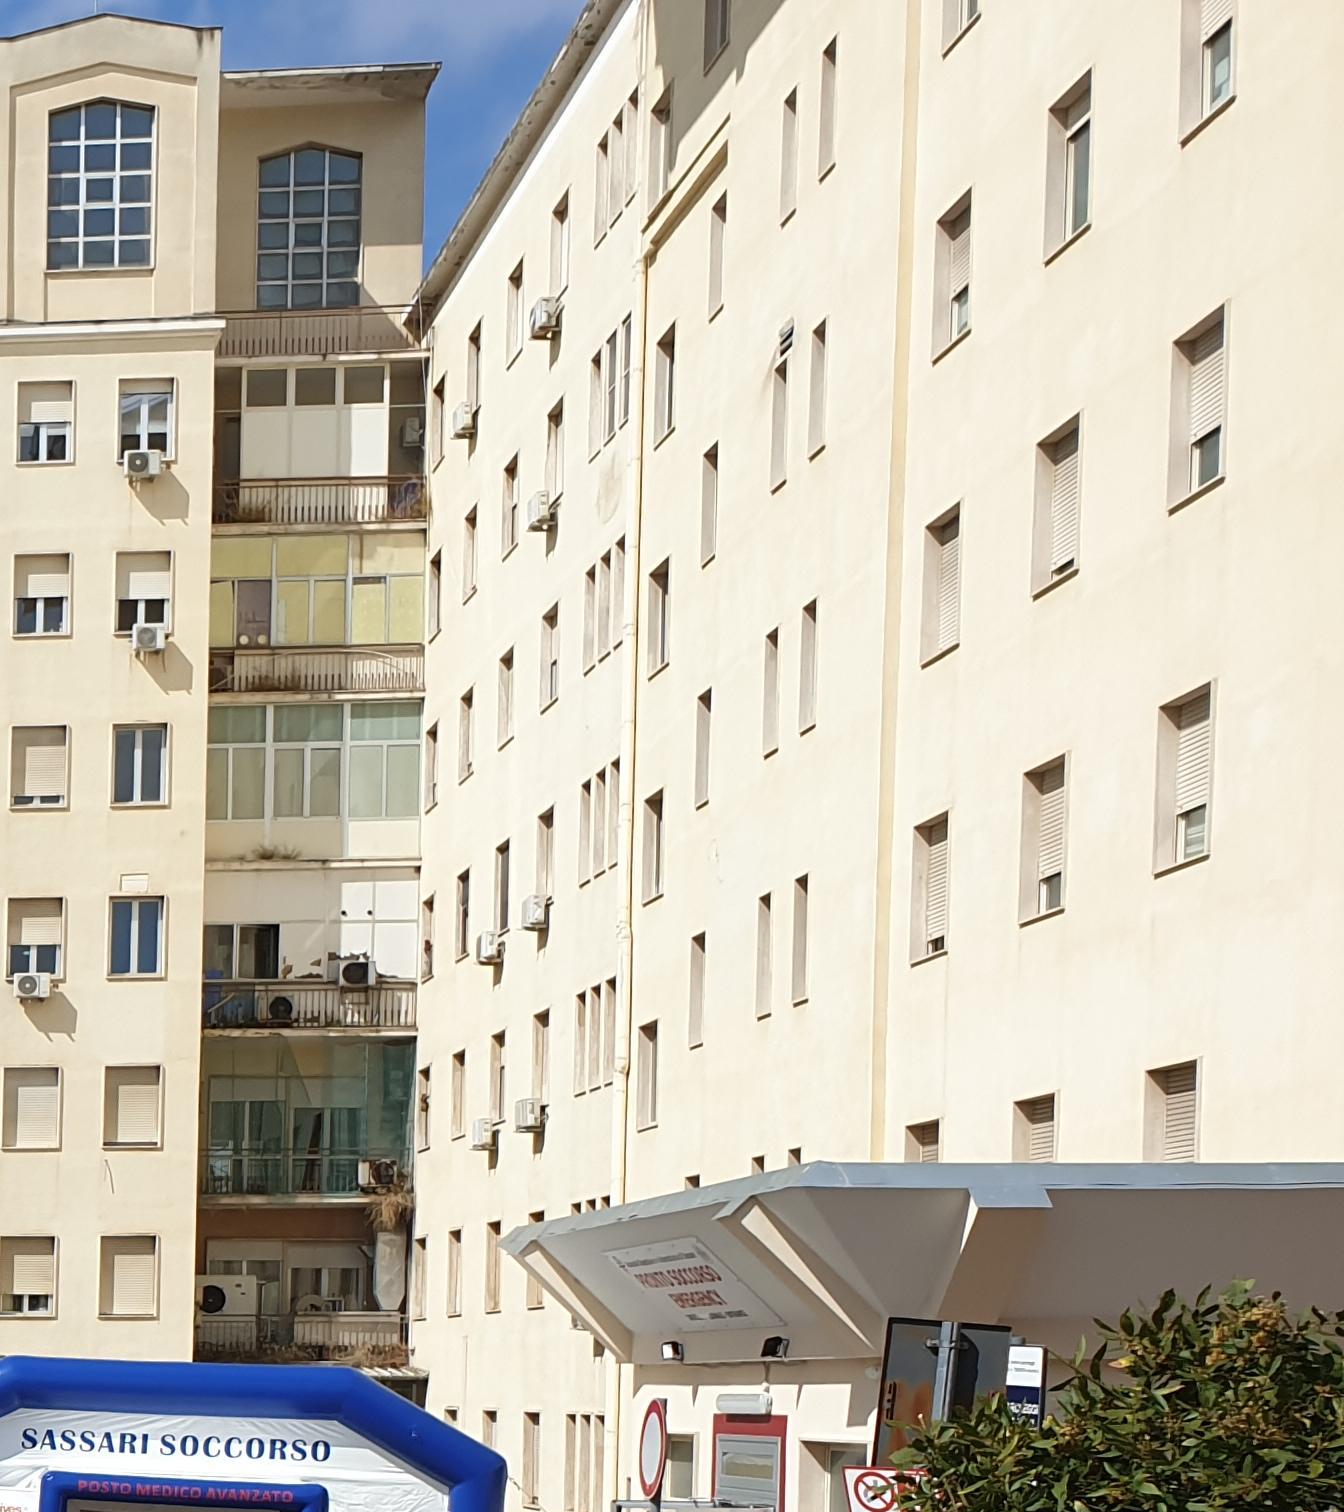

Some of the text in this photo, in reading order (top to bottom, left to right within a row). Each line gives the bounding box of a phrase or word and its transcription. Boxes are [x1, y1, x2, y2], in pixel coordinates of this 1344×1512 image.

[20, 1428, 331, 1462] SASSARI SOCCORSO
[78, 1480, 294, 1503] POSTO MEDICO AVANZATO
